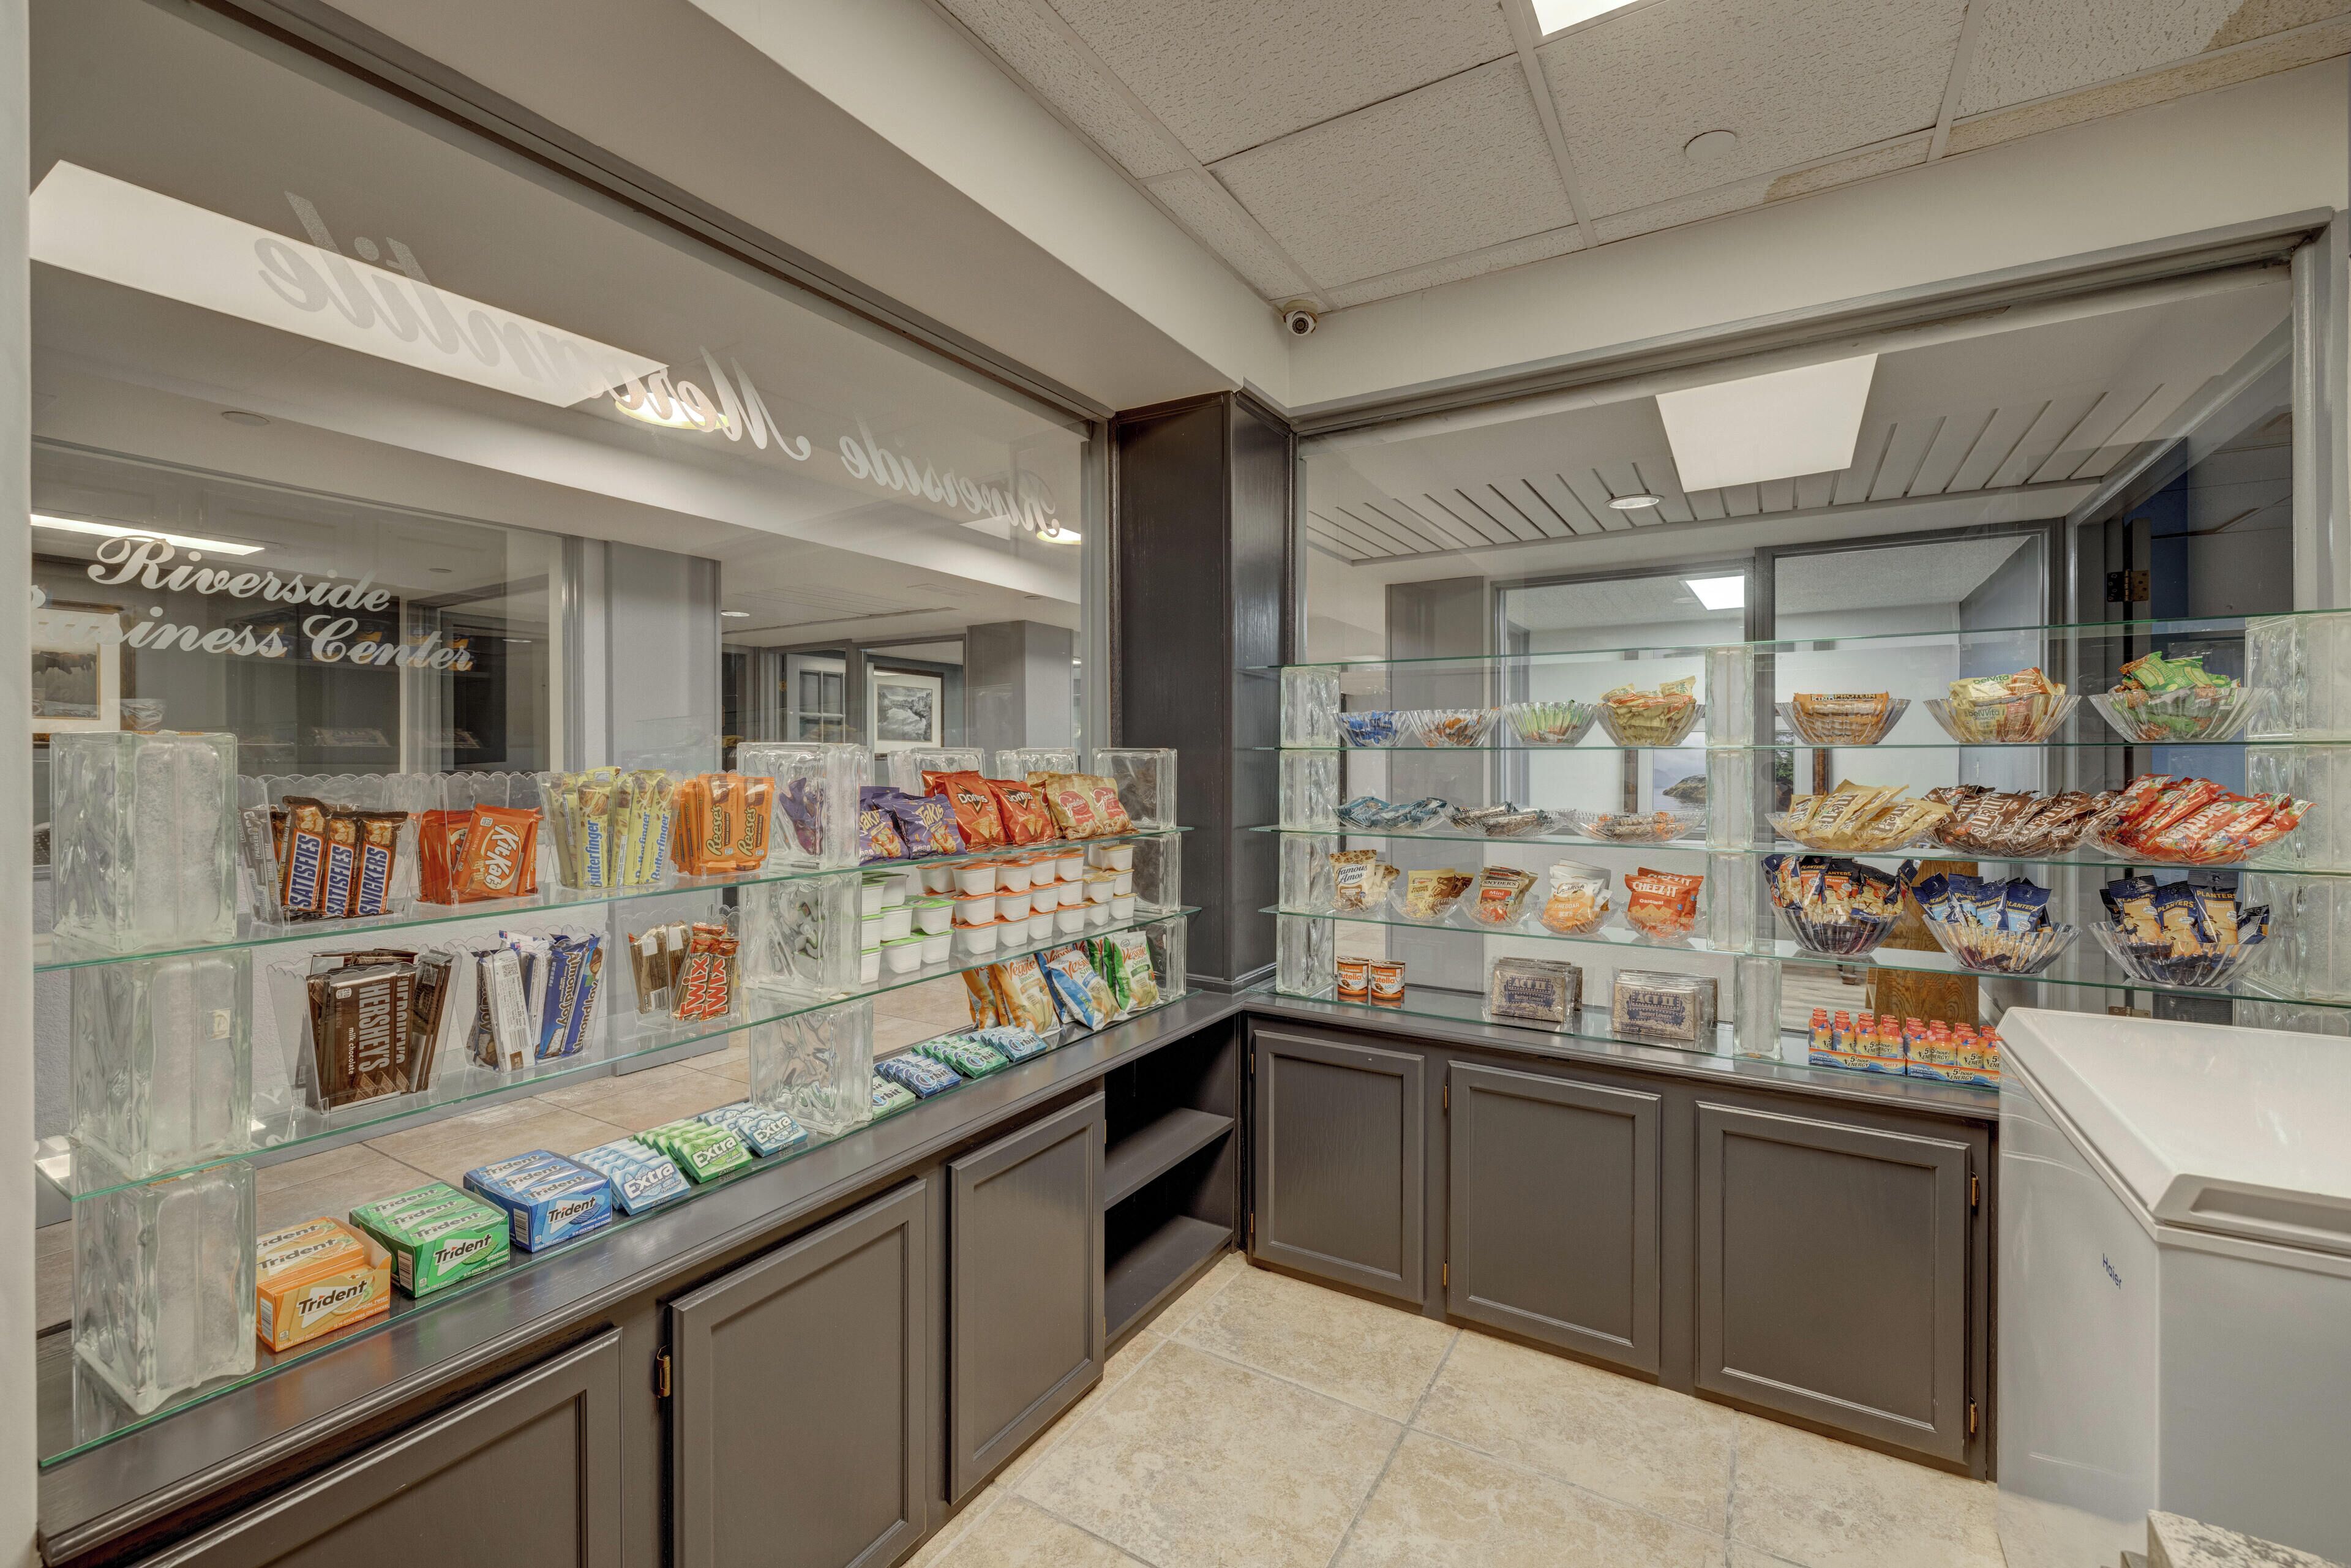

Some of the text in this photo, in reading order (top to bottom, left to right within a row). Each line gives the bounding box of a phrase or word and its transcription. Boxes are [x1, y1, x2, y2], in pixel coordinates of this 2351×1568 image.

[88, 535, 391, 612] Riverside
[31, 585, 473, 671] usiness Center
[1973, 675, 2009, 685] belVita
[958, 793, 989, 803] Doritos
[1004, 792, 1033, 802] Doritos
[706, 804, 723, 856] Reese's
[737, 806, 756, 857] Reese's
[485, 825, 520, 888] Kit Kat
[585, 820, 602, 887] Butterfinger
[651, 814, 669, 881] Butterfinger
[290, 834, 321, 909] SATISFIES
[326, 846, 352, 914] SATISFIES
[359, 847, 388, 914] SNICKERS
[1337, 865, 1368, 880] Famous
[1337, 872, 1363, 887] Amos
[1976, 896, 2002, 907] PLANTERS
[2007, 901, 2039, 910] PLANTERS
[2197, 890, 2237, 899] PLANTERS
[2158, 901, 2194, 913] PLANTERS
[1122, 946, 1147, 964] Veggie
[1003, 960, 1036, 981] Veggie
[557, 952, 581, 1026] Almond Joy
[1512, 979, 1547, 989] ACT II
[1637, 994, 1675, 1006] ACT II
[358, 983, 390, 1072] HERSHEY'S
[1007, 1036, 1038, 1053] Orbit
[964, 1051, 997, 1068] Orbit
[915, 1068, 950, 1089] Orbit
[753, 1116, 792, 1144] Extra
[692, 1136, 737, 1169] Extra
[481, 1155, 540, 1177] Trident
[500, 1165, 561, 1188] Trident
[524, 1176, 585, 1199] Trident
[624, 1163, 674, 1199] Extra
[661, 1179, 681, 1193] PEPPERMINT
[370, 1189, 437, 1212] Trident
[388, 1200, 457, 1225] Trident
[549, 1196, 596, 1223] Trident
[257, 1225, 318, 1249] rident
[411, 1212, 480, 1239] Trident
[257, 1238, 337, 1269] Trident
[435, 1234, 492, 1264] Trident
[2102, 1253, 2121, 1290] Haier
[299, 1280, 367, 1315] Trident
